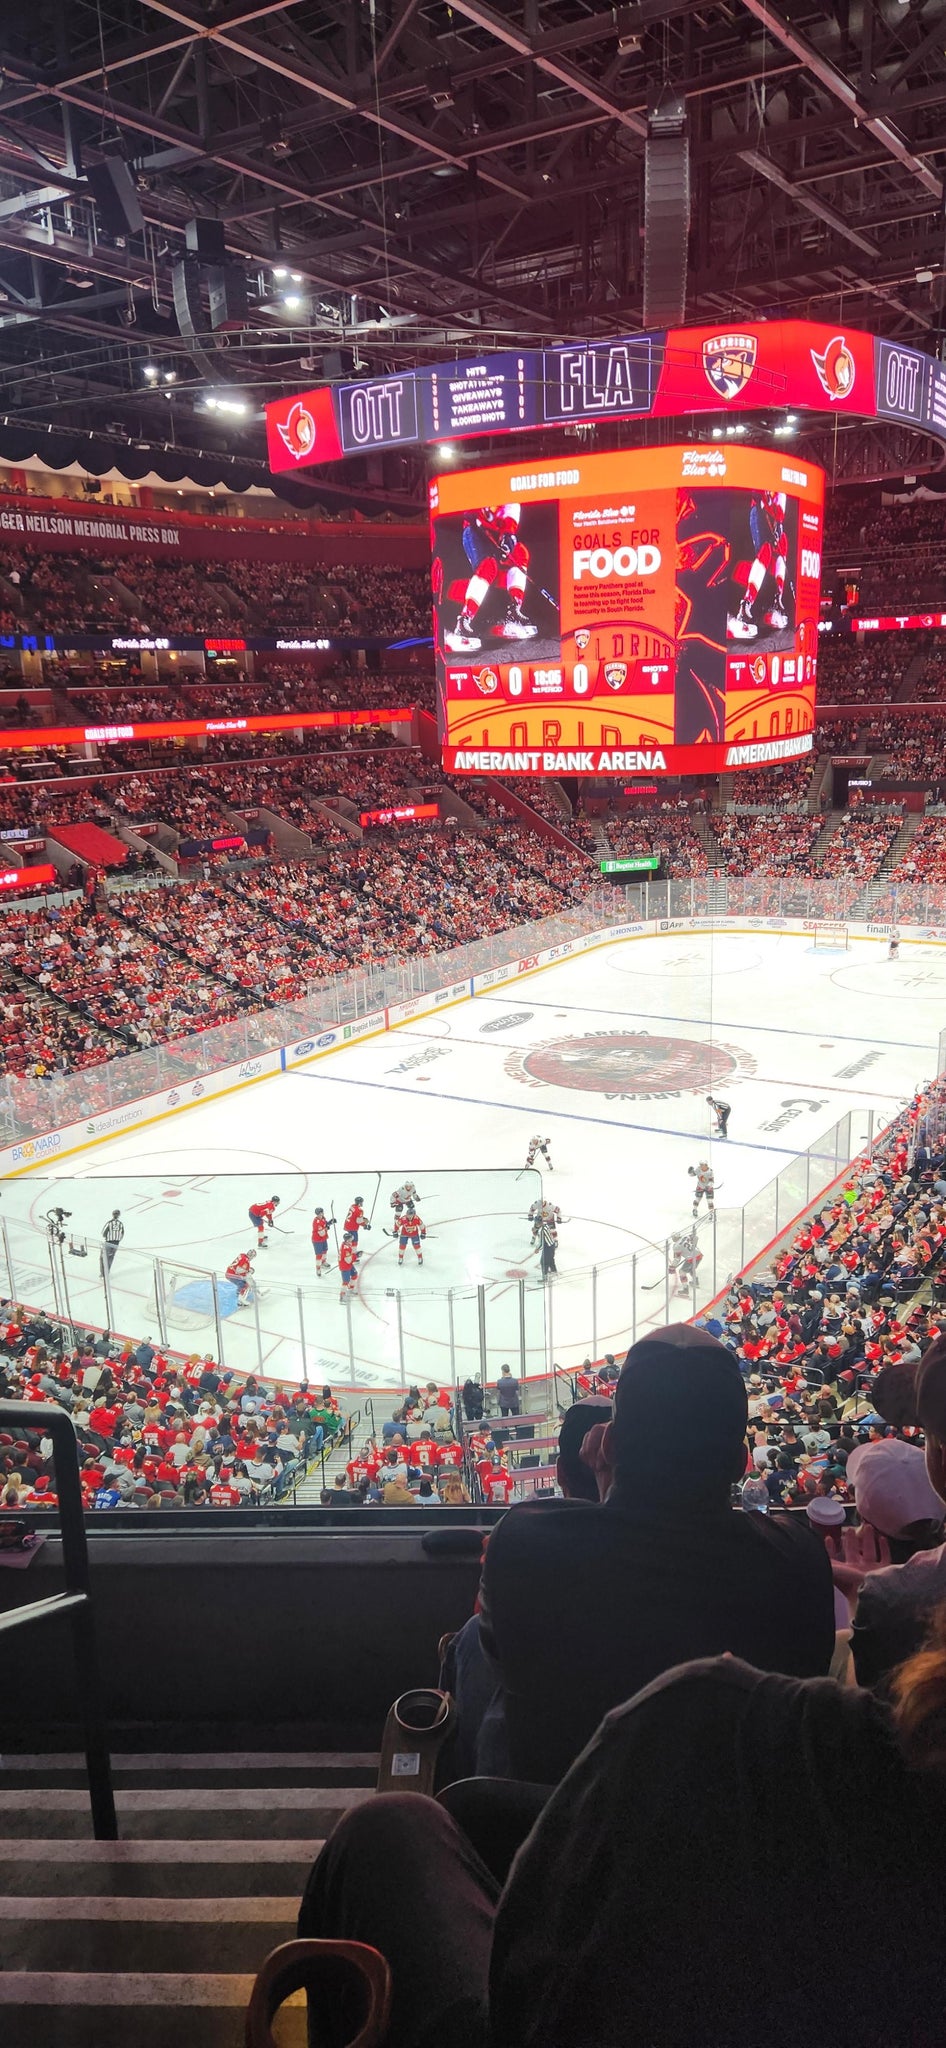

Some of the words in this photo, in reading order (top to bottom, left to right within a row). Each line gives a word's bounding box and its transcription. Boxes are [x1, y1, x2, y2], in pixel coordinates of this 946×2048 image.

[707, 337, 753, 353] FLORIDA
[466, 366, 487, 377] HITS
[561, 347, 633, 411] FLA
[449, 379, 468, 392] SHOT
[886, 350, 920, 413] OTT
[452, 388, 502, 403] GIVEAWAYS
[350, 381, 403, 443] OTT
[452, 399, 504, 415] TAKEAWAYS
[451, 414, 481, 427] BLOCKED
[482, 411, 506, 424] SHOTS
[682, 450, 724, 463] Florida
[682, 464, 706, 476] Blue
[510, 476, 537, 492] GOALS
[538, 474, 555, 488] FOR
[556, 469, 580, 485] FOOD
[573, 510, 602, 520] Florida
[0, 512, 24, 531] GER
[26, 515, 73, 535] NEILSON
[75, 520, 129, 540] MEMORIAL
[130, 526, 160, 544] PRESS
[161, 529, 180, 545] BOX
[573, 532, 622, 550] GOALS
[631, 529, 660, 546] FOR
[573, 544, 661, 580] FOOD
[624, 581, 637, 589] goal
[580, 600, 601, 608] teaming
[616, 597, 630, 605] fight
[623, 604, 645, 612] Florida.
[112, 638, 140, 648] Florida
[140, 639, 155, 648] Blue
[276, 640, 301, 649] Florida
[301, 641, 316, 649] Blue
[642, 665, 668, 673] SHOTS
[771, 655, 780, 685] 0
[508, 667, 522, 696] 0
[573, 664, 588, 694] 0
[85, 728, 105, 740] GOALS
[106, 727, 117, 739] FOR
[118, 726, 134, 737] FOOD
[726, 738, 784, 766] AMERANT
[454, 752, 542, 770] AMERANT
[543, 752, 595, 771] BANK
[597, 751, 667, 771] ARENA
[615, 926, 644, 935] HONDA
[518, 955, 540, 973] DEX
[352, 1021, 368, 1034] Baptist
[368, 1016, 384, 1029] Health
[584, 1030, 649, 1038] ARENA
[763, 1108, 803, 1132] CELSIUS
[12, 1134, 61, 1160] BROWARD
[36, 1146, 61, 1159] COUNTY
